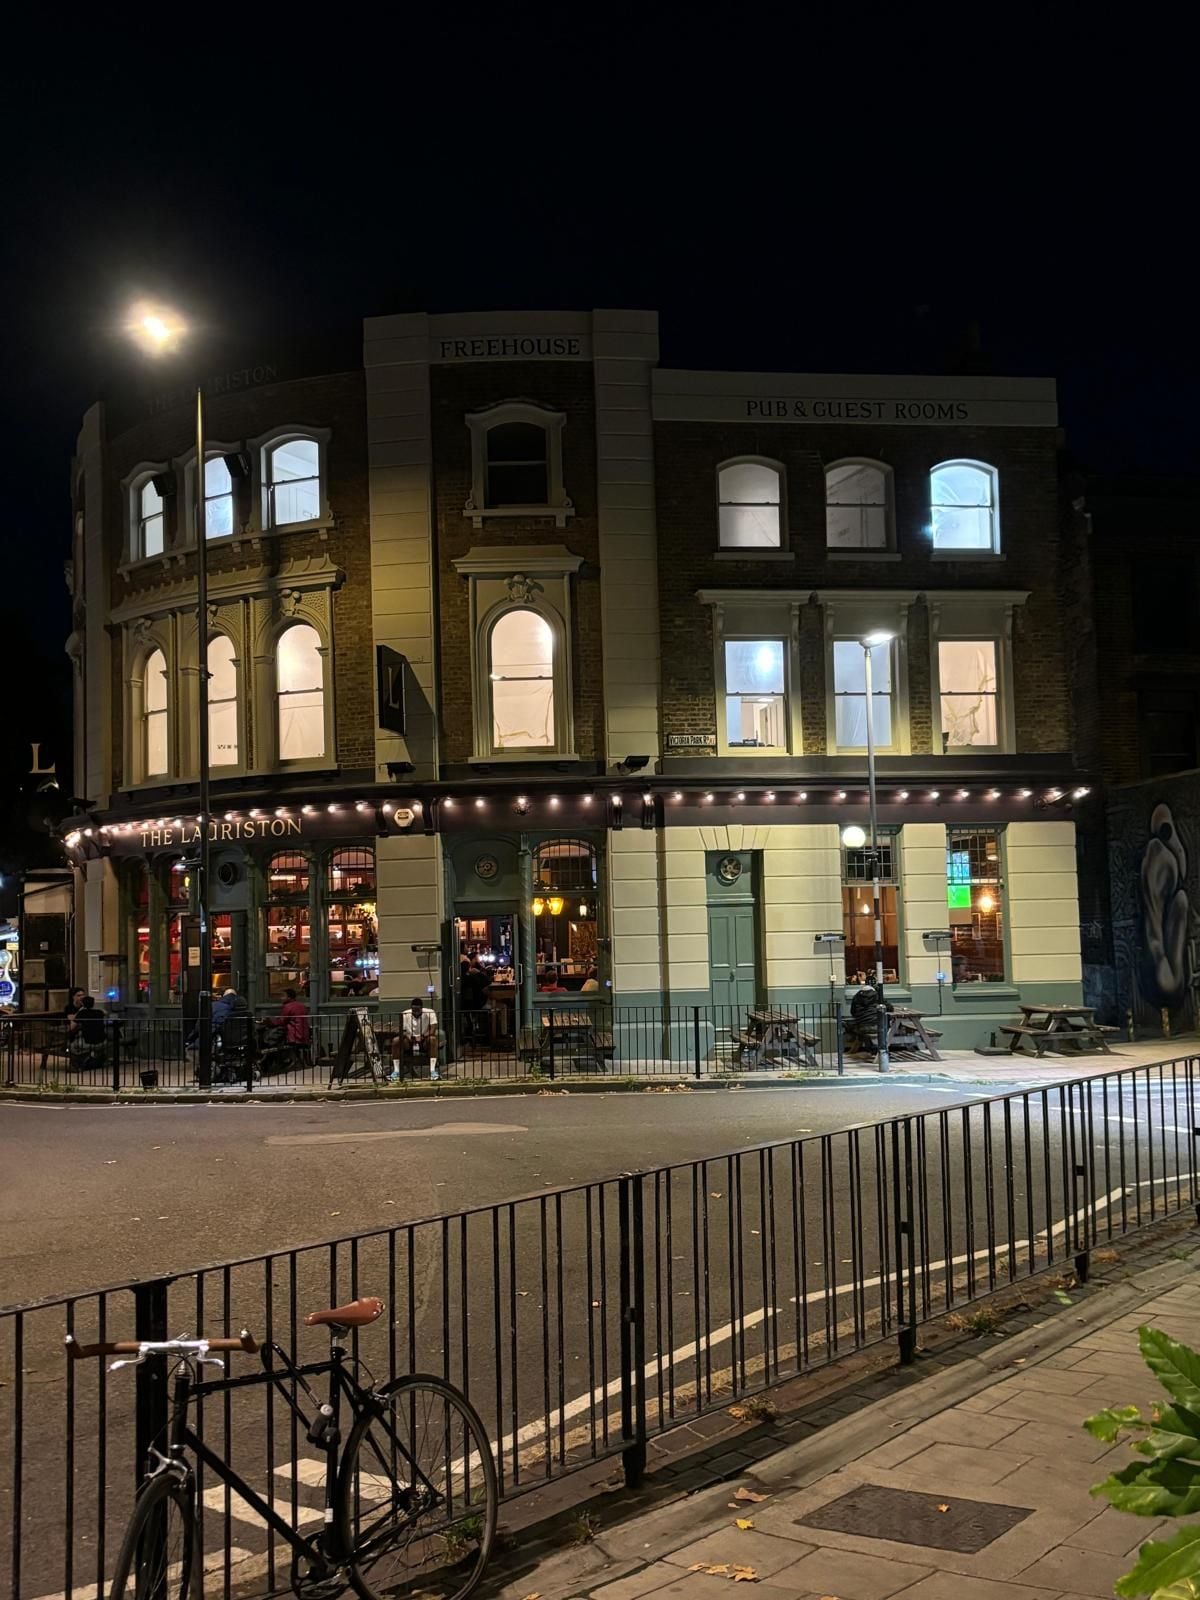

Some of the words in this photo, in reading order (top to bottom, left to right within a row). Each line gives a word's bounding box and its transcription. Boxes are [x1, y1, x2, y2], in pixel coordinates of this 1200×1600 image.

[440, 338, 580, 358] FREEHOUSE
[746, 400, 788, 417] PUB
[793, 401, 808, 418] &
[813, 401, 885, 418] GUEST
[895, 402, 969, 420] ROOMS
[670, 736, 689, 744] VICTORIA
[690, 735, 703, 744] PARK
[28, 743, 56, 774] L
[140, 829, 173, 848] THE
